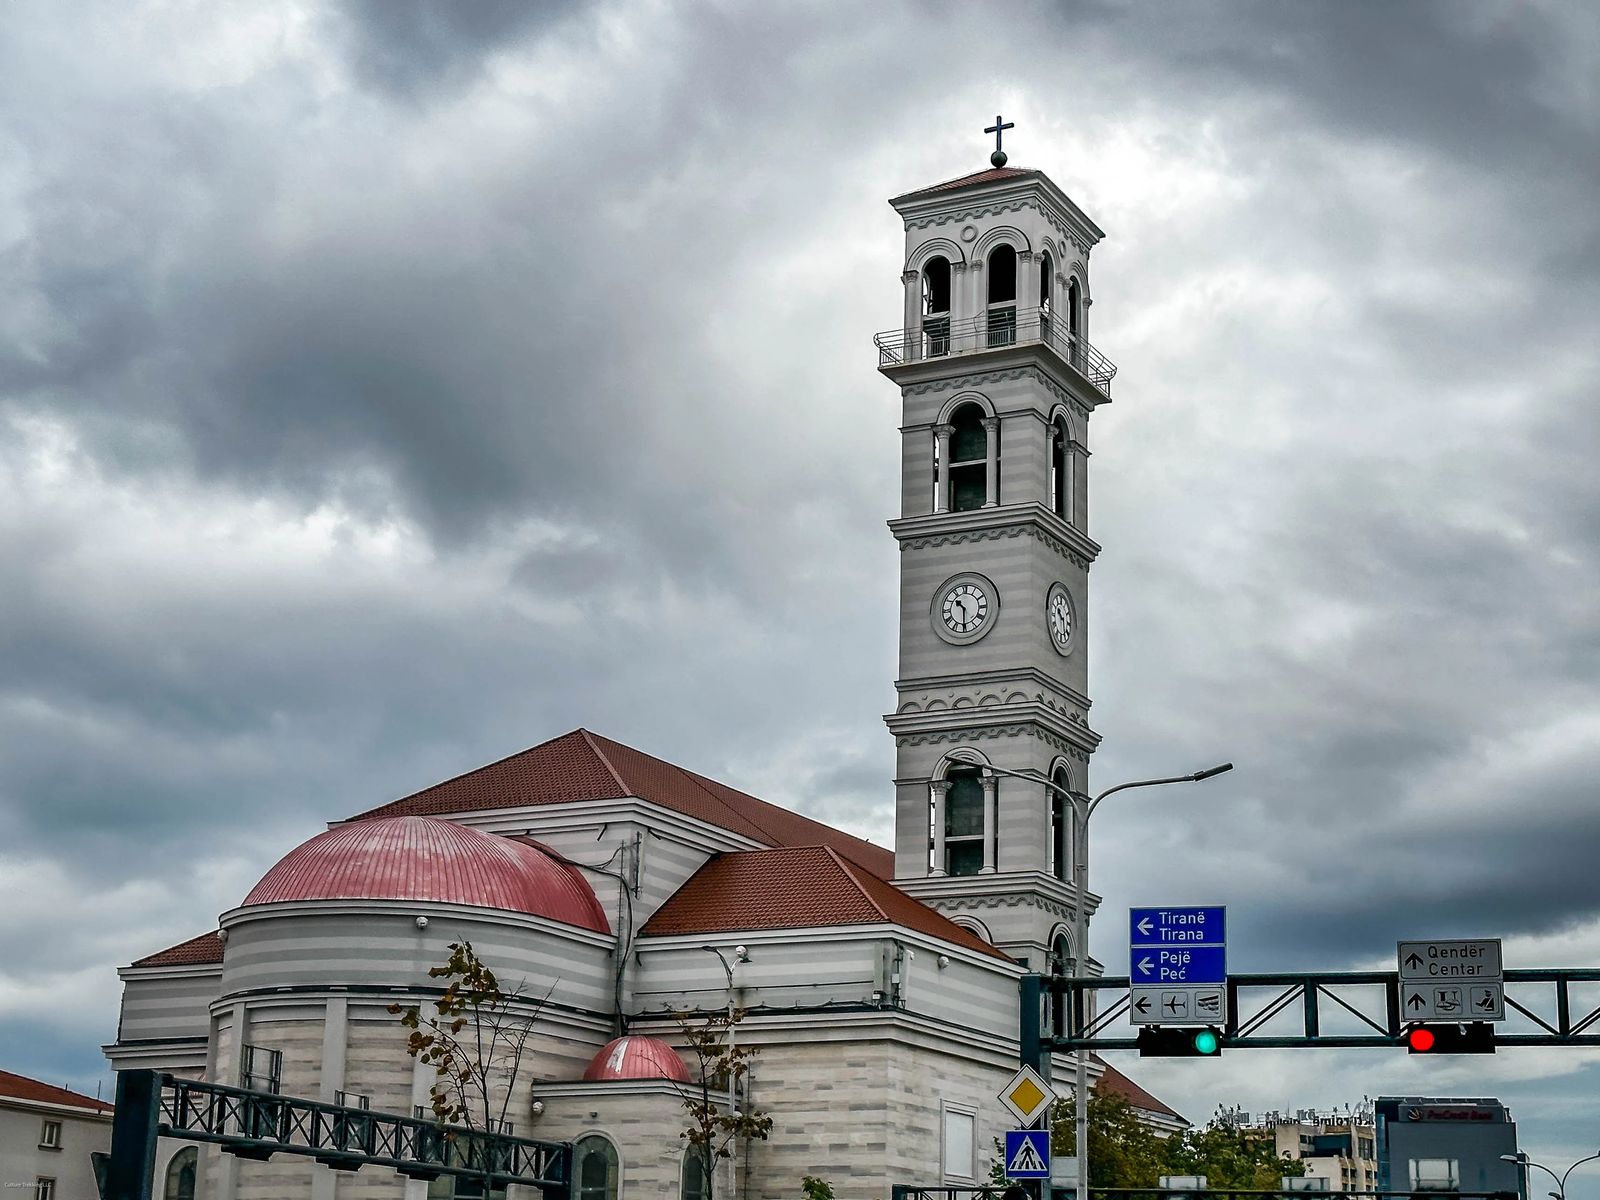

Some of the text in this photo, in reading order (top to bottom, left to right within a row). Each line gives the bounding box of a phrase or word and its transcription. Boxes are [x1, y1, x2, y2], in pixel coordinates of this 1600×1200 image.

[1159, 911, 1205, 924] Tiranë
[1159, 928, 1204, 941] Tirana
[1428, 945, 1485, 959] Qendër
[1160, 951, 1191, 967] Pejë
[1160, 967, 1186, 980] Peć
[1429, 962, 1484, 976] Centar
